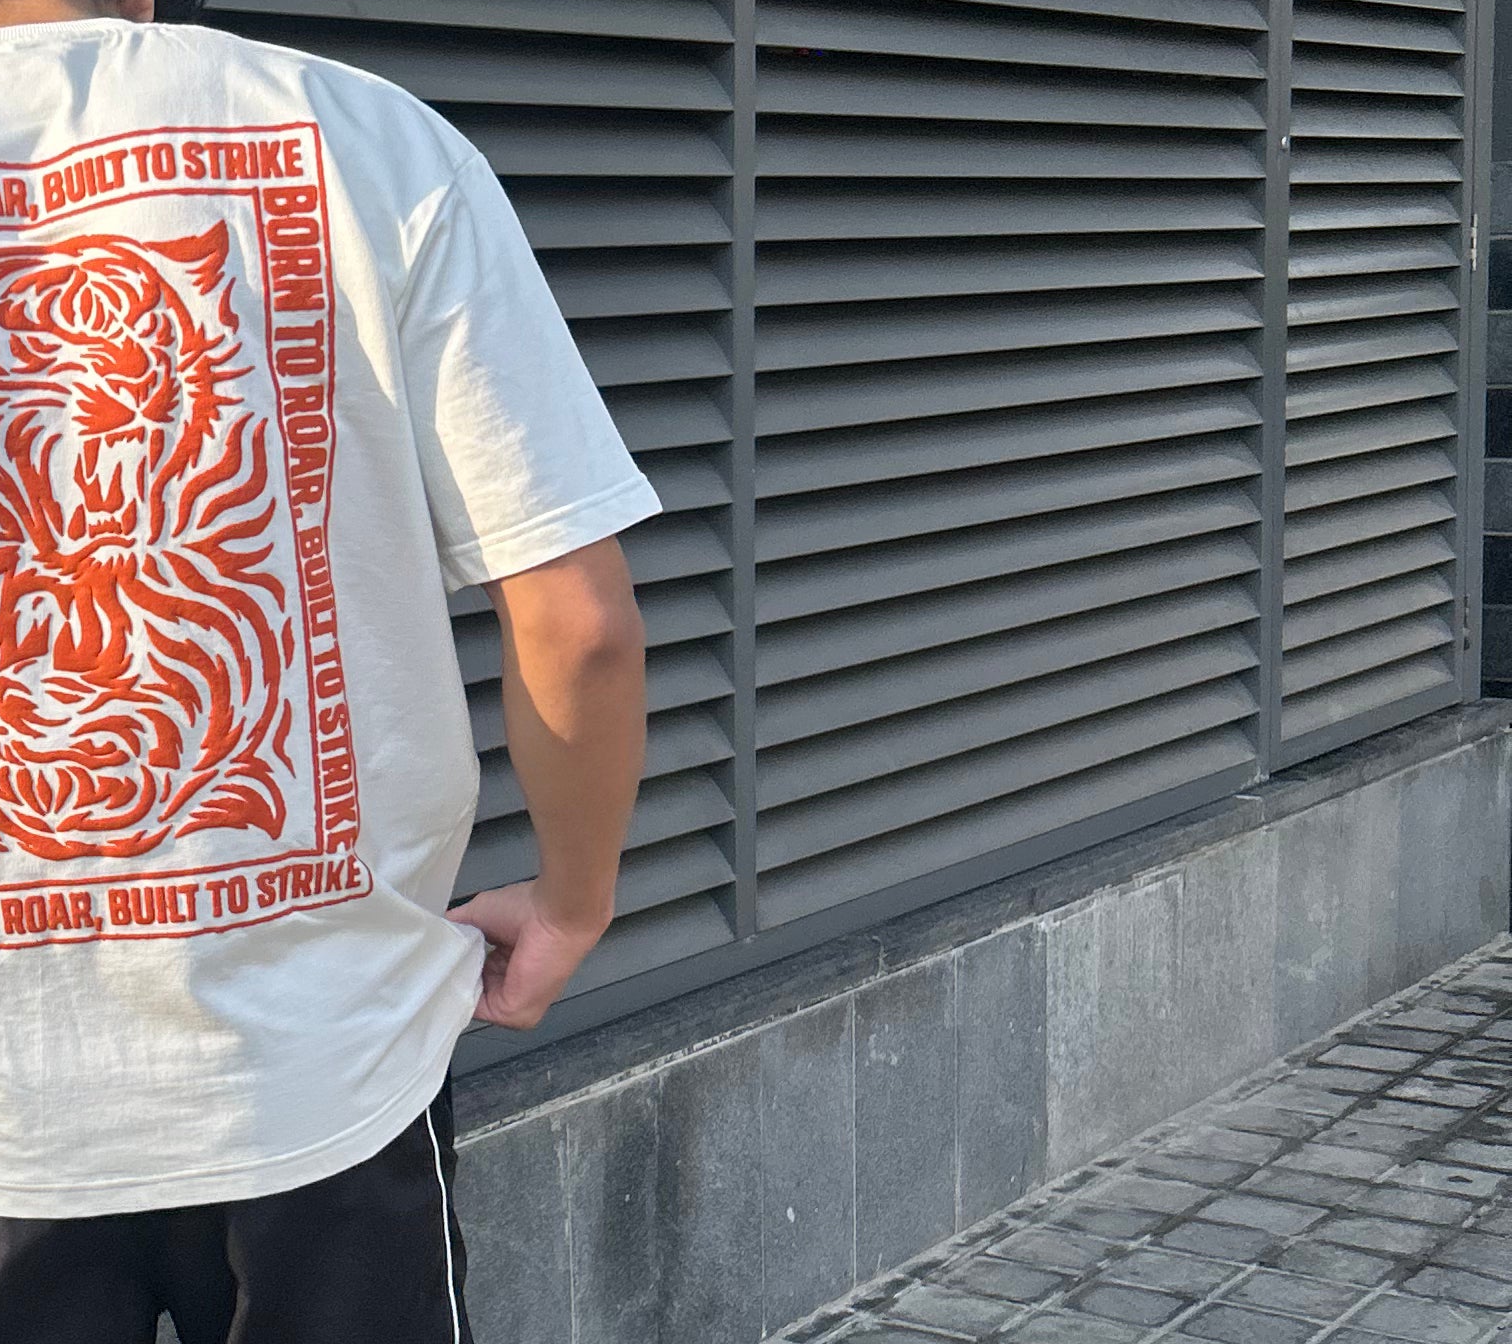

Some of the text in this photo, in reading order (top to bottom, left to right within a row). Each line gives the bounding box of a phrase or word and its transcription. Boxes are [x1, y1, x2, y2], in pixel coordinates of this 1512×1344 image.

[41, 147, 129, 209] BUILT
[127, 142, 178, 183] TO
[183, 138, 306, 182] STRIKE
[263, 185, 325, 312] BORN
[274, 319, 325, 378] TO
[297, 526, 336, 639] BUILT
[314, 642, 344, 698] TO
[317, 701, 358, 855] STRIKE
[1, 891, 104, 935] ROAR,
[109, 885, 200, 926] BUILT
[205, 874, 248, 918] TO
[255, 859, 362, 909] STRIKE
